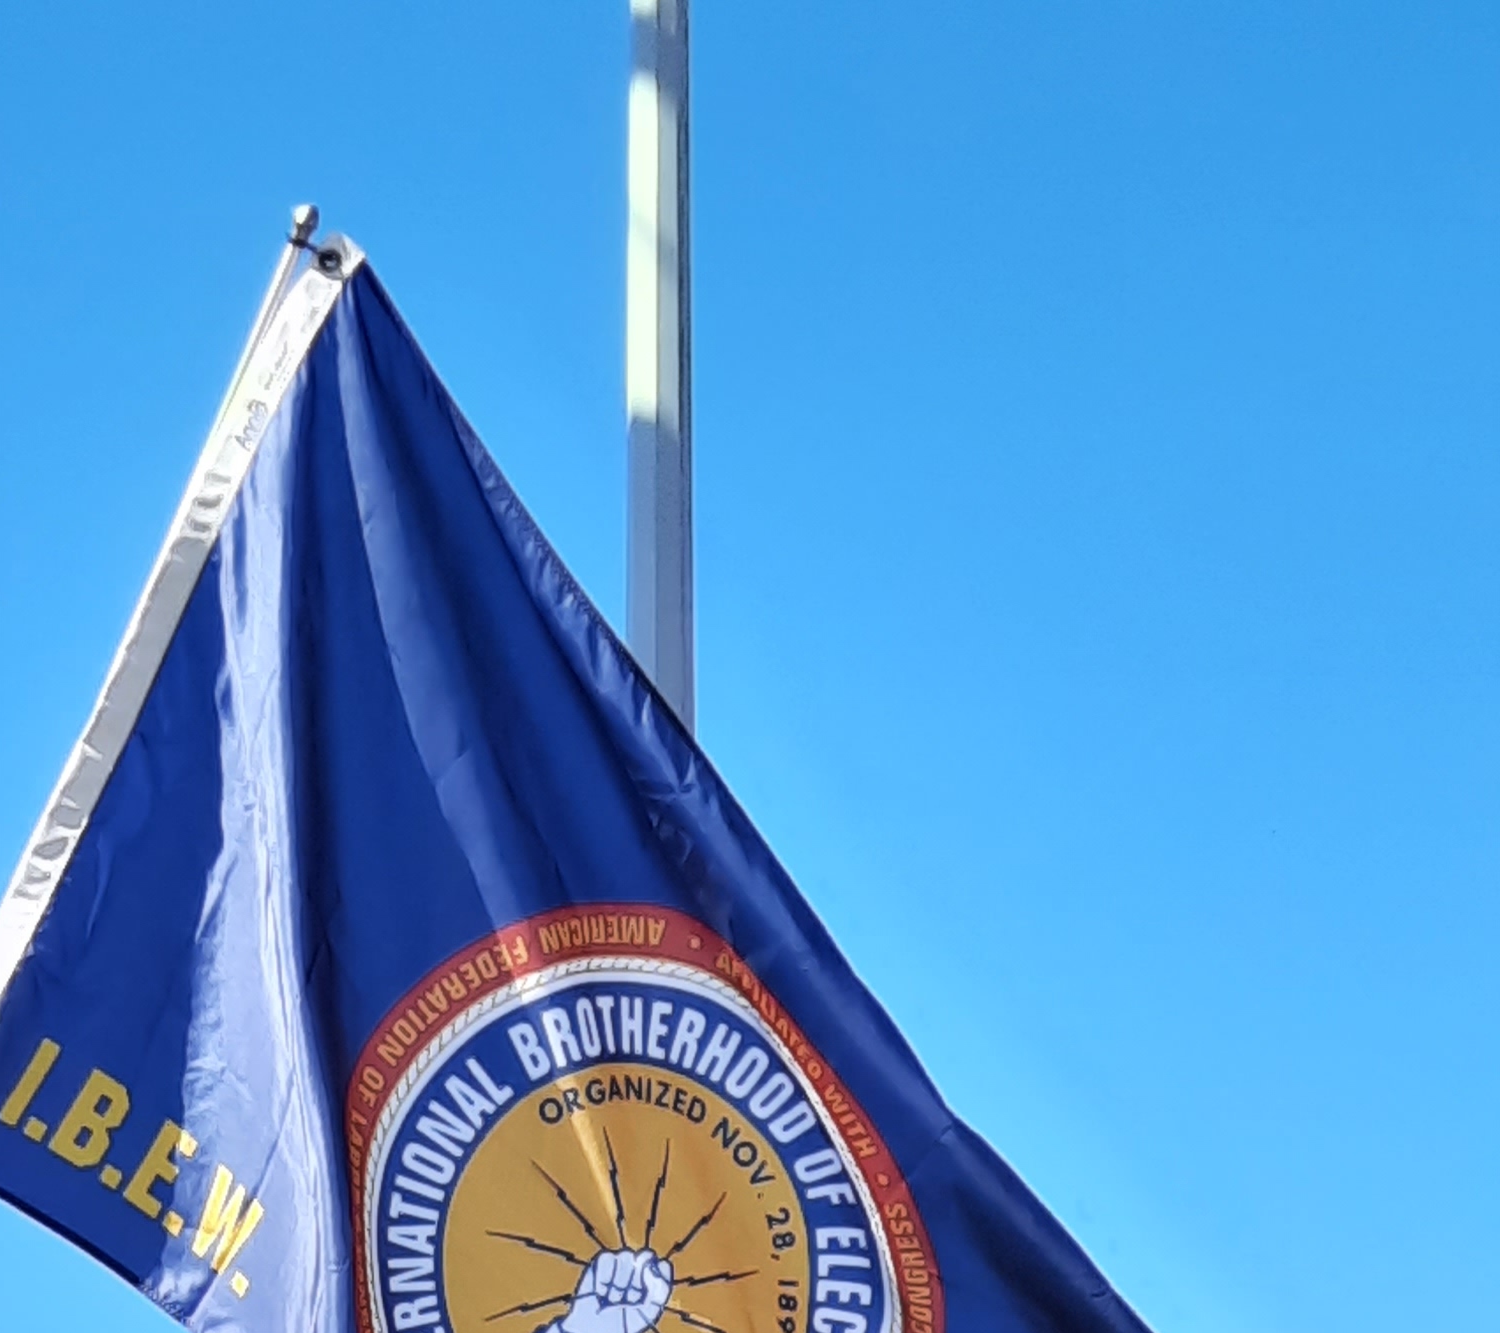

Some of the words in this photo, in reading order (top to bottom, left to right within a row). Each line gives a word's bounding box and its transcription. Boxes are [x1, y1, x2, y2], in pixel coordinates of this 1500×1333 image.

[539, 914, 667, 955] AMERICAN
[377, 935, 530, 1068] FEDERATION
[358, 1065, 385, 1109] OF
[507, 995, 817, 1144] BROTHERHOOD
[793, 1148, 858, 1205] OF
[823, 1084, 878, 1159] WITH
[0, 1037, 265, 1298] I.B.E.W.
[540, 1074, 707, 1125] ORGANIZED
[711, 1116, 776, 1199] NOV.
[765, 1207, 796, 1261] 28,
